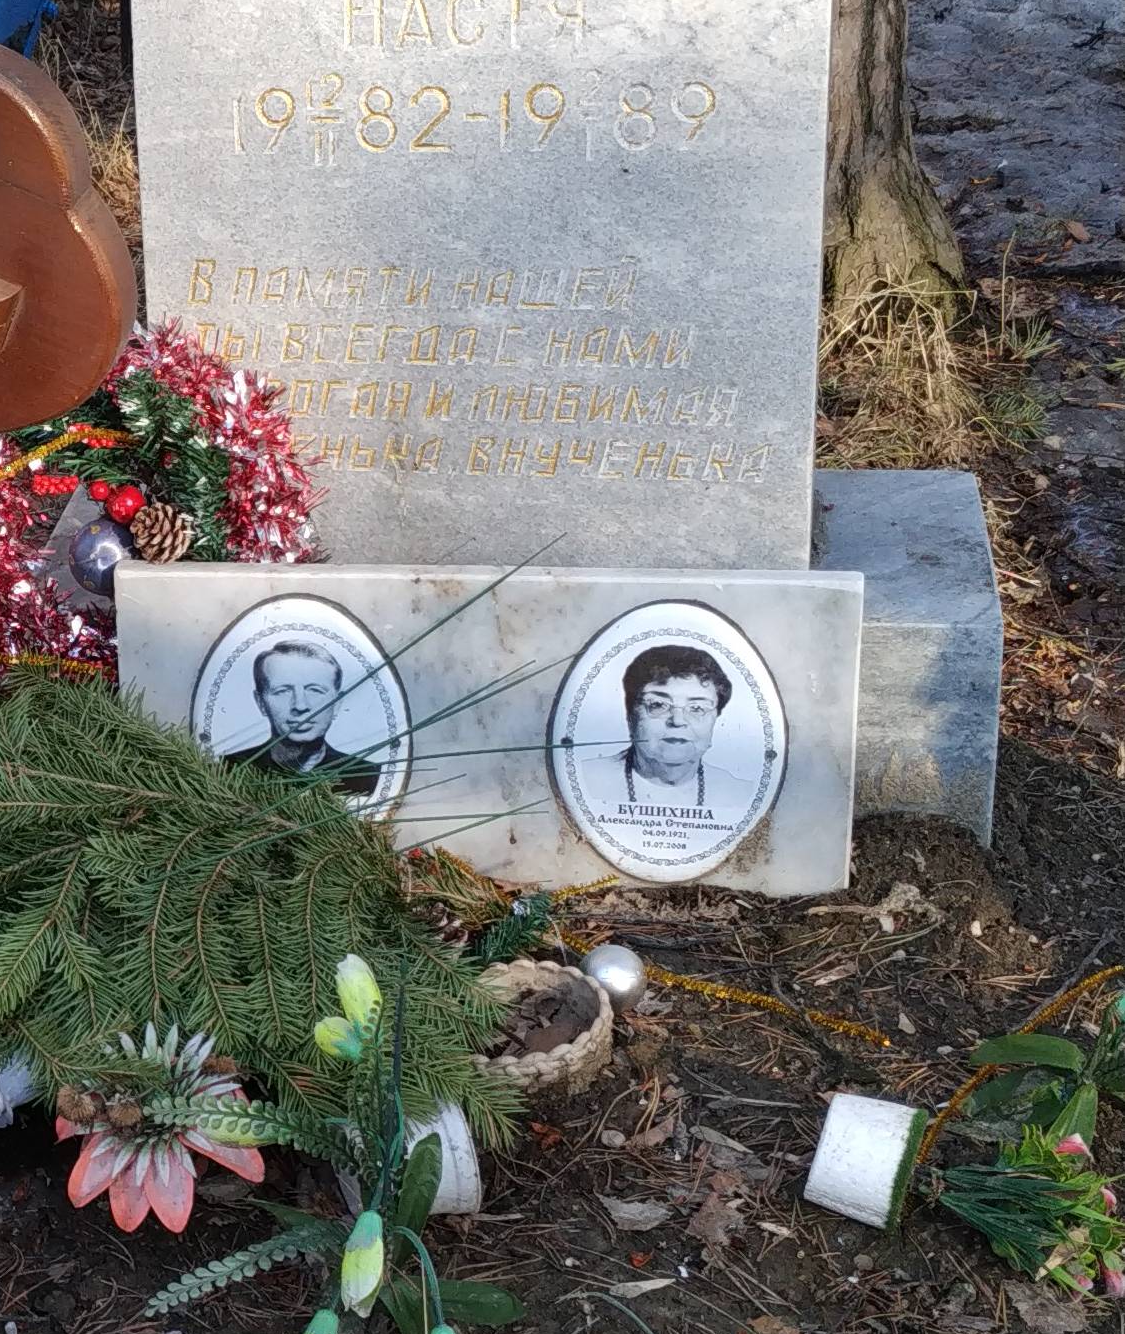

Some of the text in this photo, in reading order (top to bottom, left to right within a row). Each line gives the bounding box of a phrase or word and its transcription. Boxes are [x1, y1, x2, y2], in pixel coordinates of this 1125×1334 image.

[187, 255, 639, 310] В ПАМЯТИ НАШЕЙ
[194, 321, 696, 369] ТЫ ВСЕГДА С НАМИ
[425, 380, 454, 422] И
[469, 383, 739, 427] ЛЮБИМАЯ
[467, 436, 773, 484] ВНУЧЕНЬКА
[597, 814, 734, 832] Александра Степановна
[617, 803, 715, 821] БУШИХИНА
